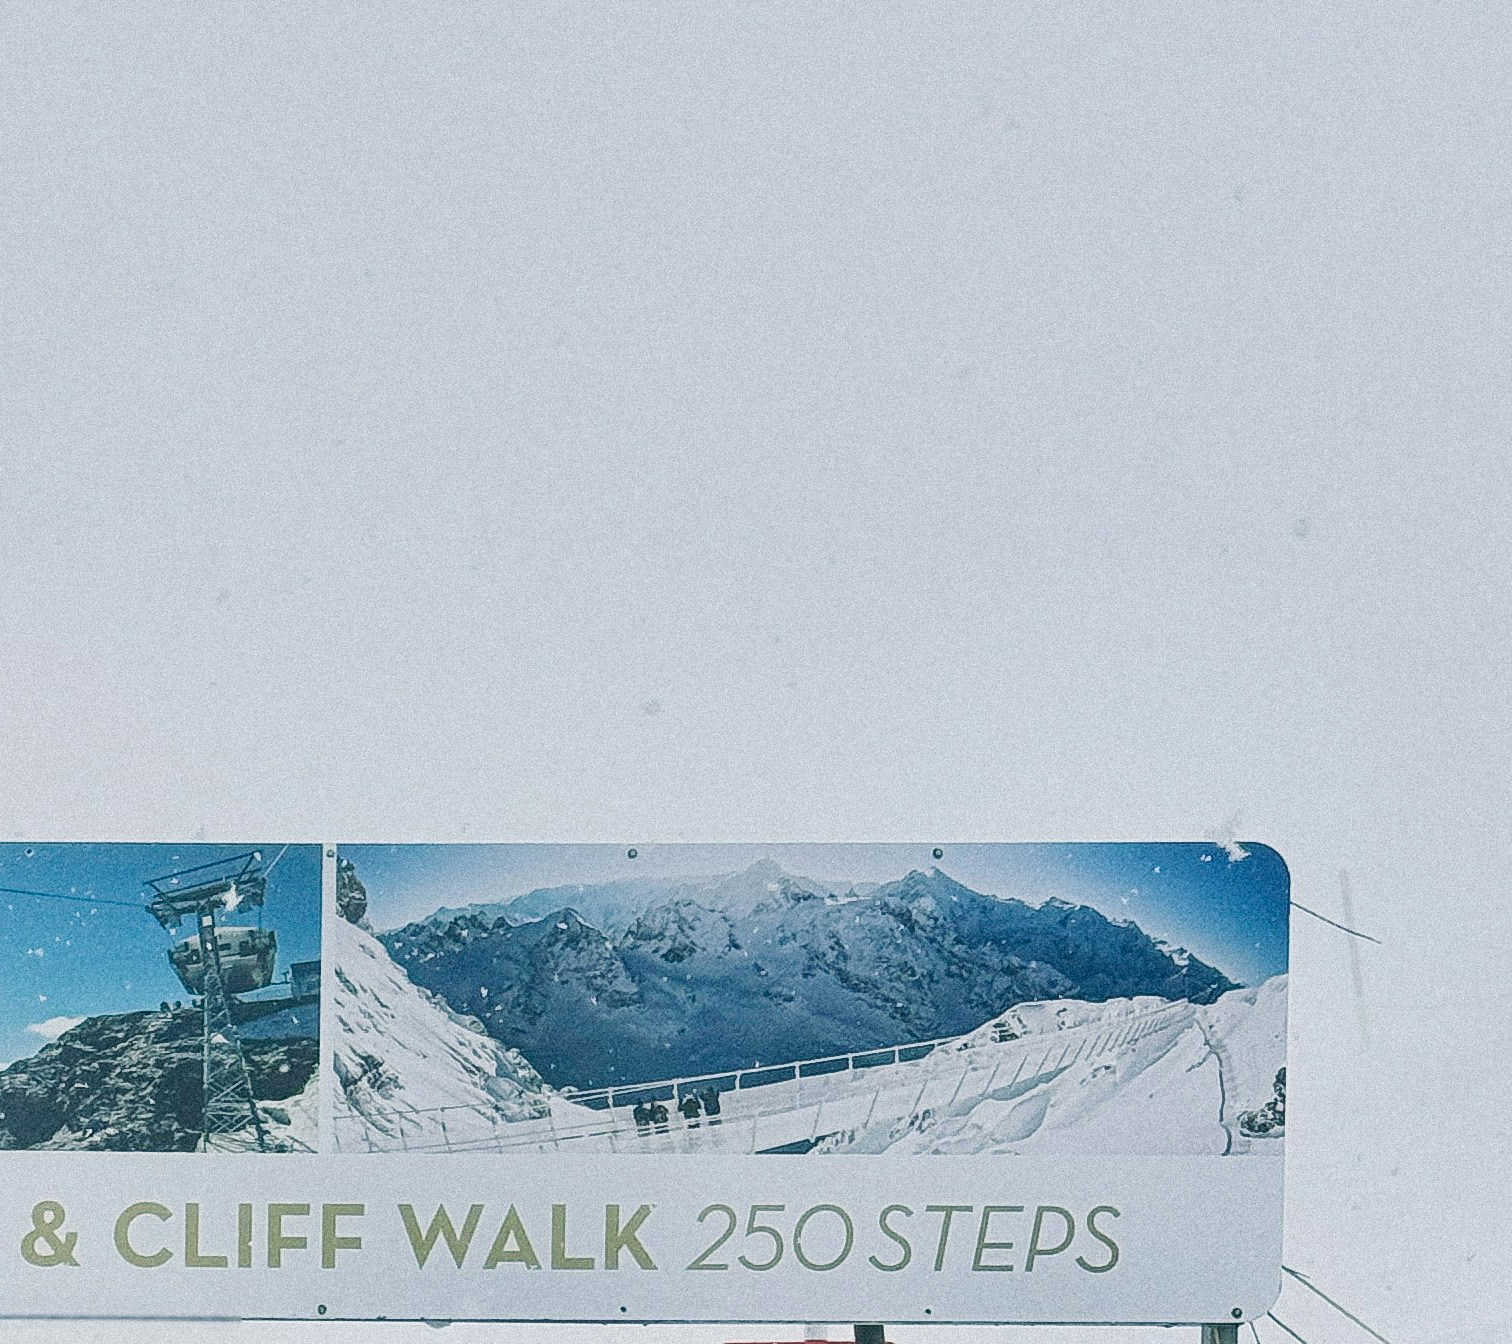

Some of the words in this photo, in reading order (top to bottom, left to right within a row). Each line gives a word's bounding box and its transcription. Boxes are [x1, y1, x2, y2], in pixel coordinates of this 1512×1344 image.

[20, 1199, 81, 1267] &
[113, 1201, 365, 1269] CLIFF
[396, 1203, 658, 1271] WALK
